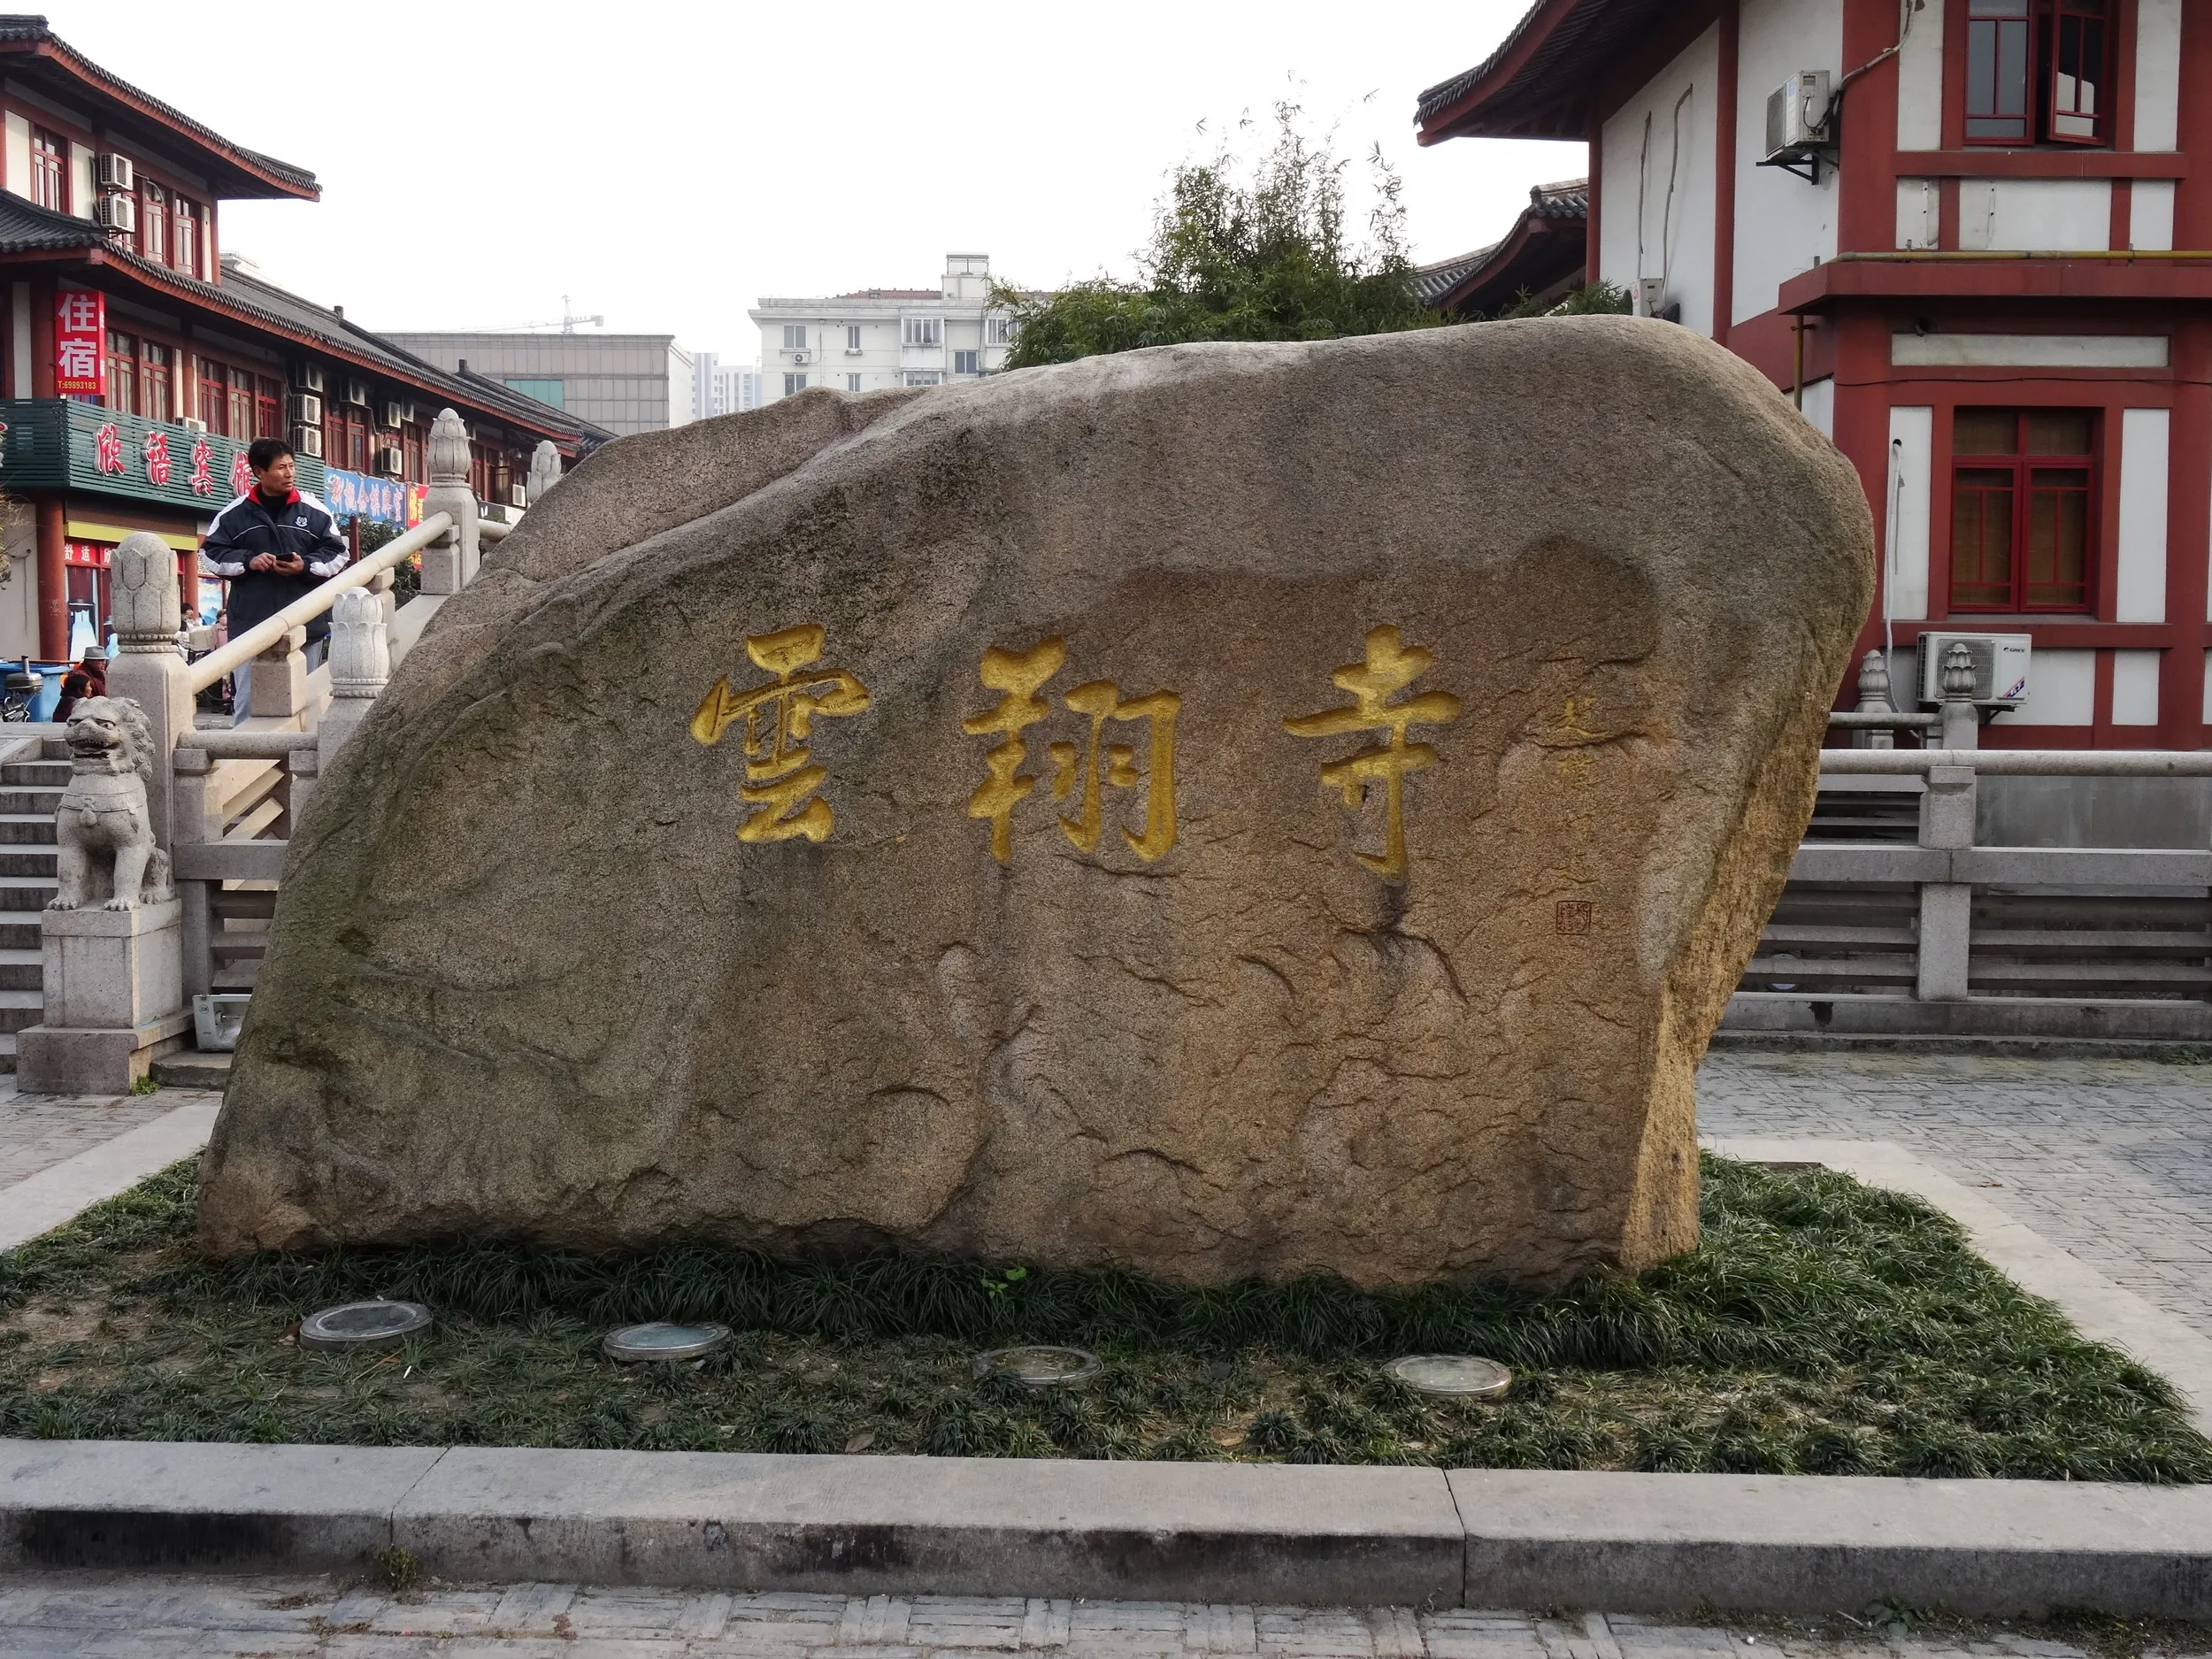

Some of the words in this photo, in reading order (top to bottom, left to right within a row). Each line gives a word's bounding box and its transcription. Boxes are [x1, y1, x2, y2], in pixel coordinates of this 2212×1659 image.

[58, 293, 97, 378] 住宿
[58, 380, 96, 389] T:69893183
[691, 624, 1461, 885] 雲翔寺
